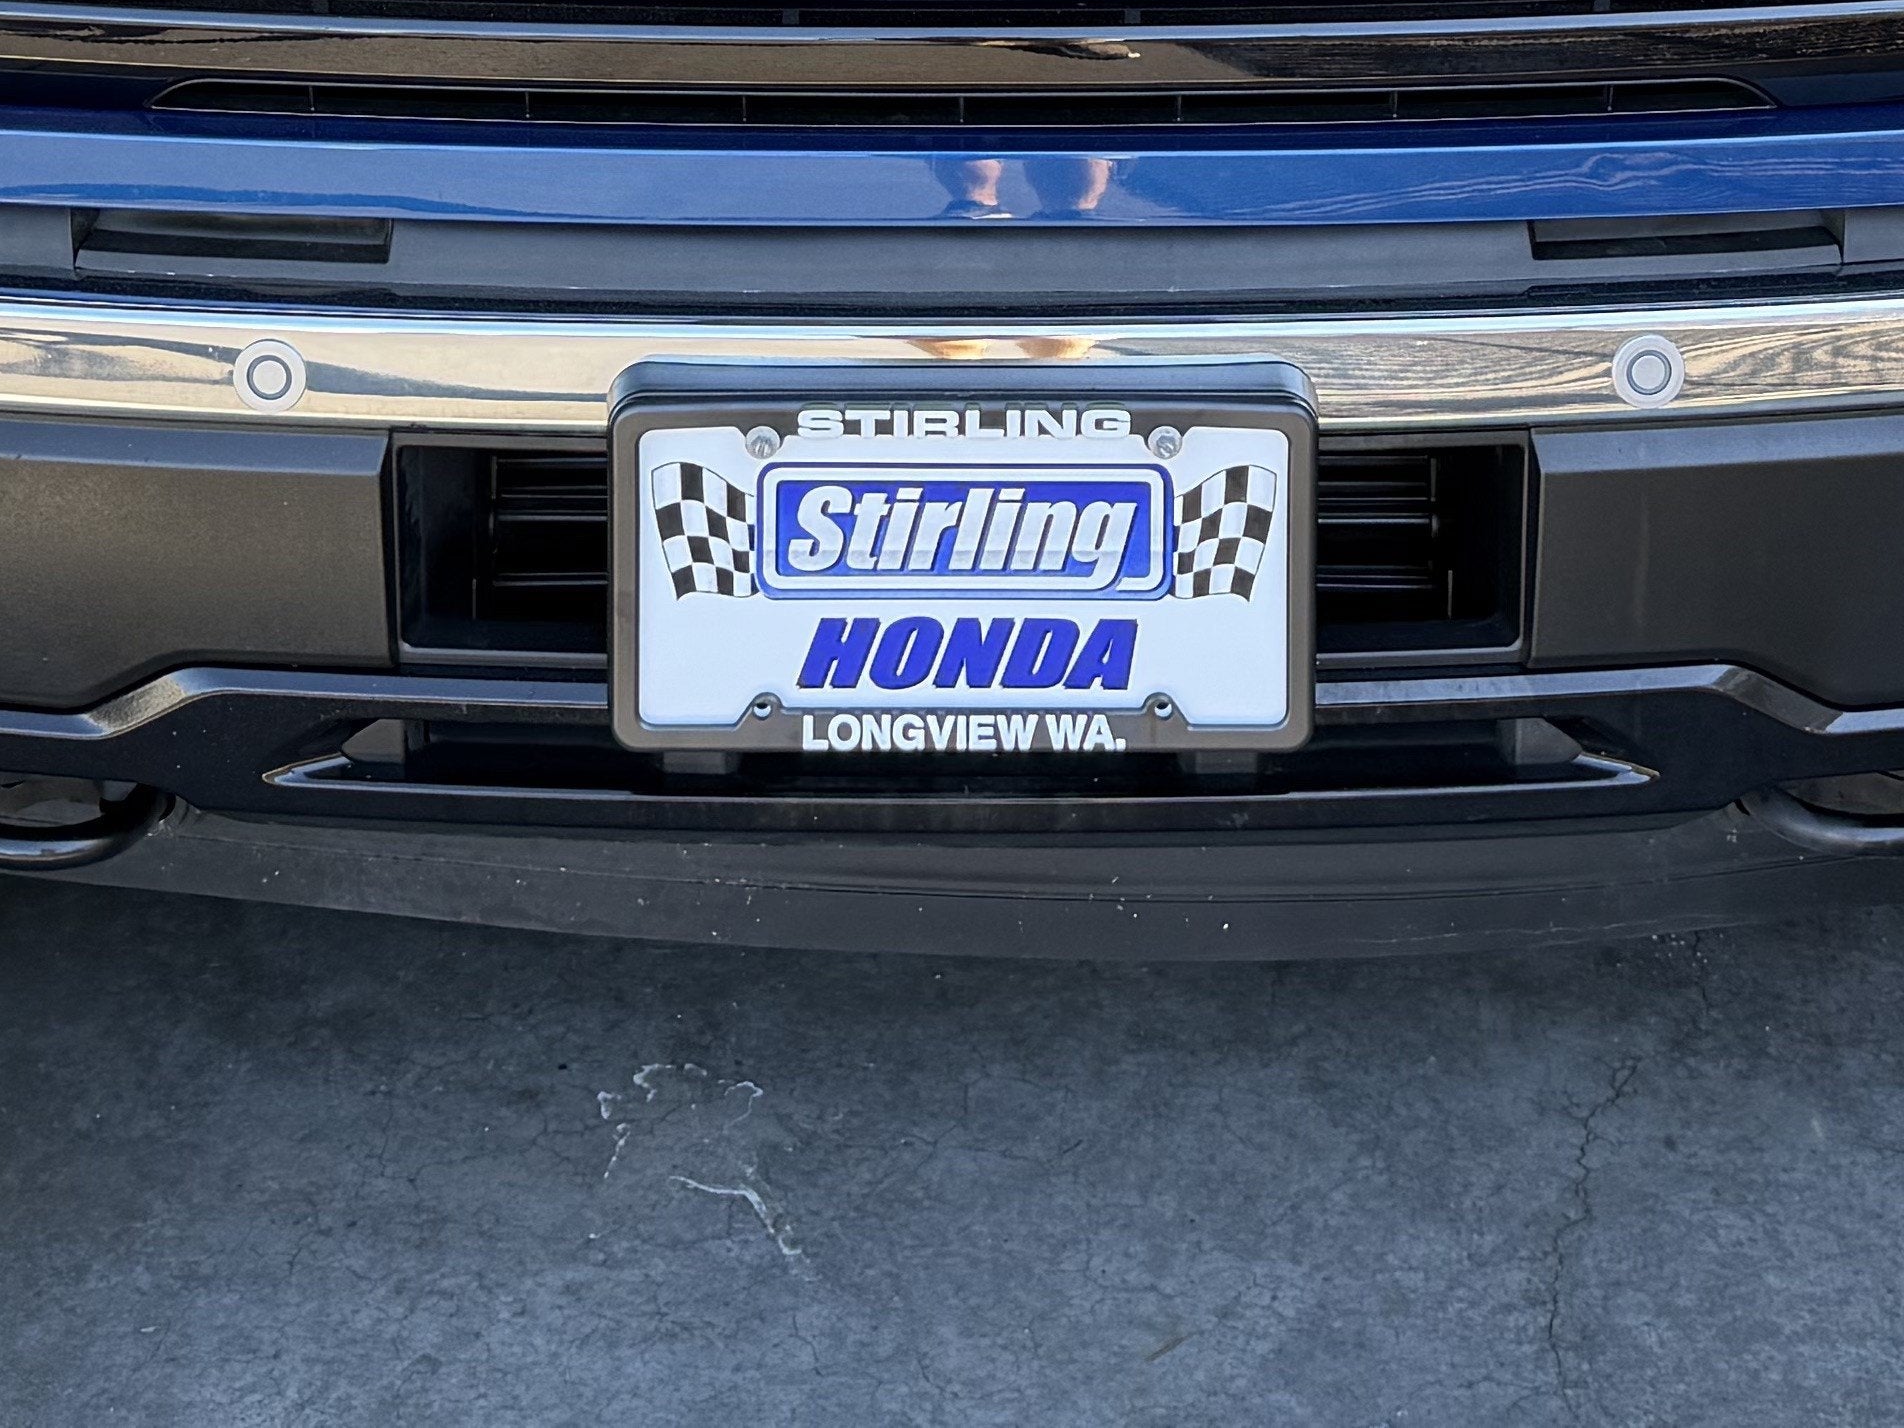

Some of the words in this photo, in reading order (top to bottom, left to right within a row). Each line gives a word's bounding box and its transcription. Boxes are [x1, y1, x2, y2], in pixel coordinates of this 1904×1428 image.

[796, 408, 1133, 440] STIRLING
[788, 485, 1139, 592] Stirling
[795, 615, 1139, 692] HONDA
[800, 713, 1043, 753] LONGVIEW
[1048, 713, 1127, 753] WA.
